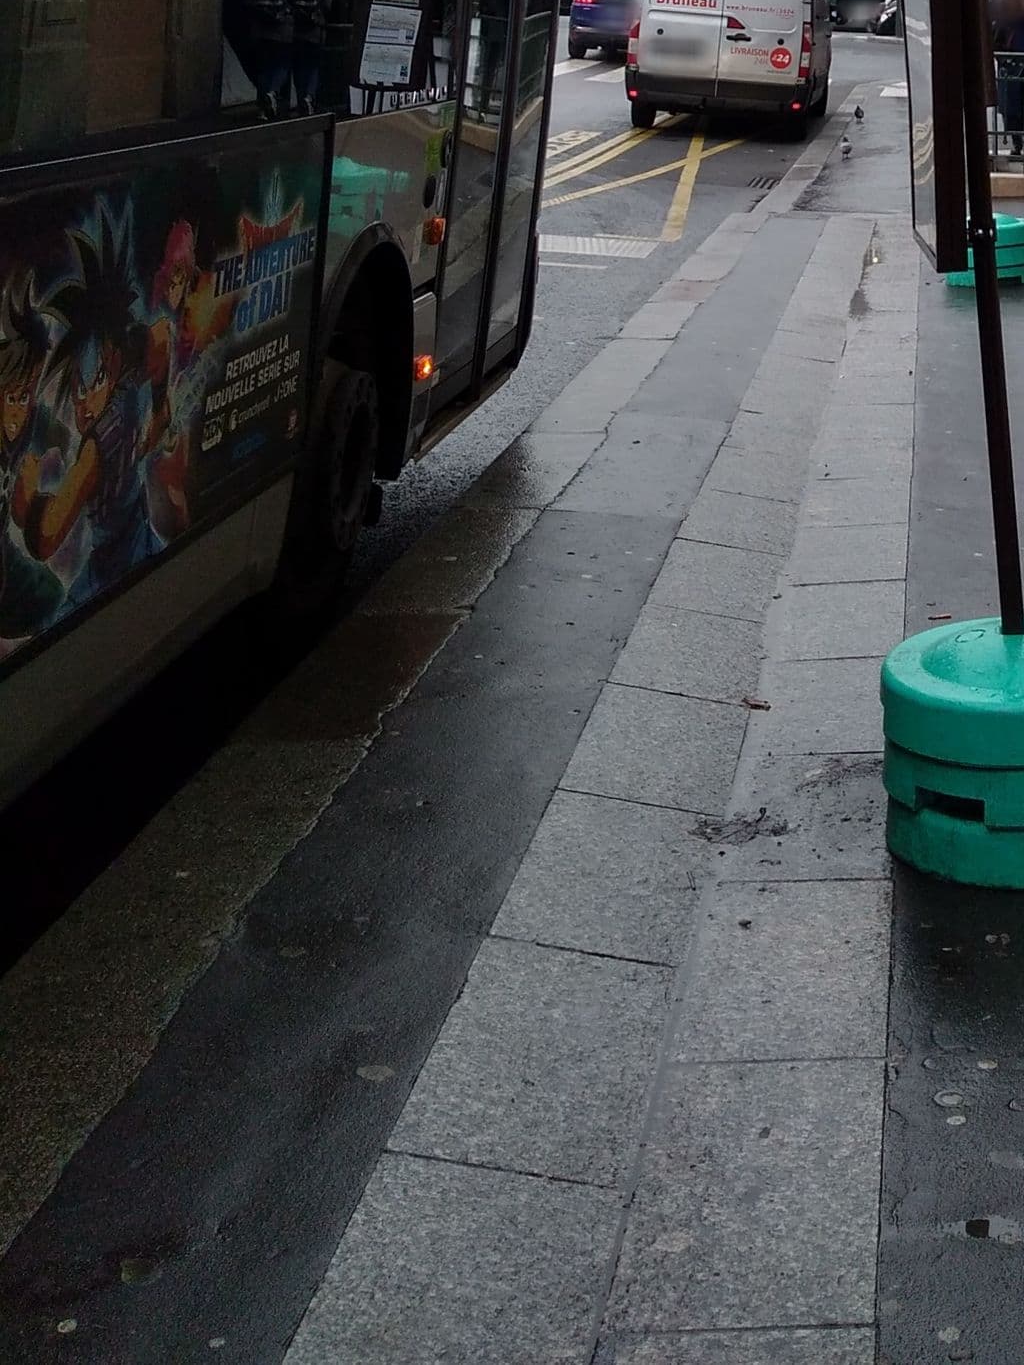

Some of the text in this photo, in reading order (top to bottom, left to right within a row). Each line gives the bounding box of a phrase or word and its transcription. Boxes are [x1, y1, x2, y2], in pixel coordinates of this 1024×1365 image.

[730, 47, 769, 57] LIVRAISON
[225, 333, 290, 382] RETROUVEZ LA
[205, 373, 257, 416] NOUVELLE
[282, 349, 301, 373] SUR
